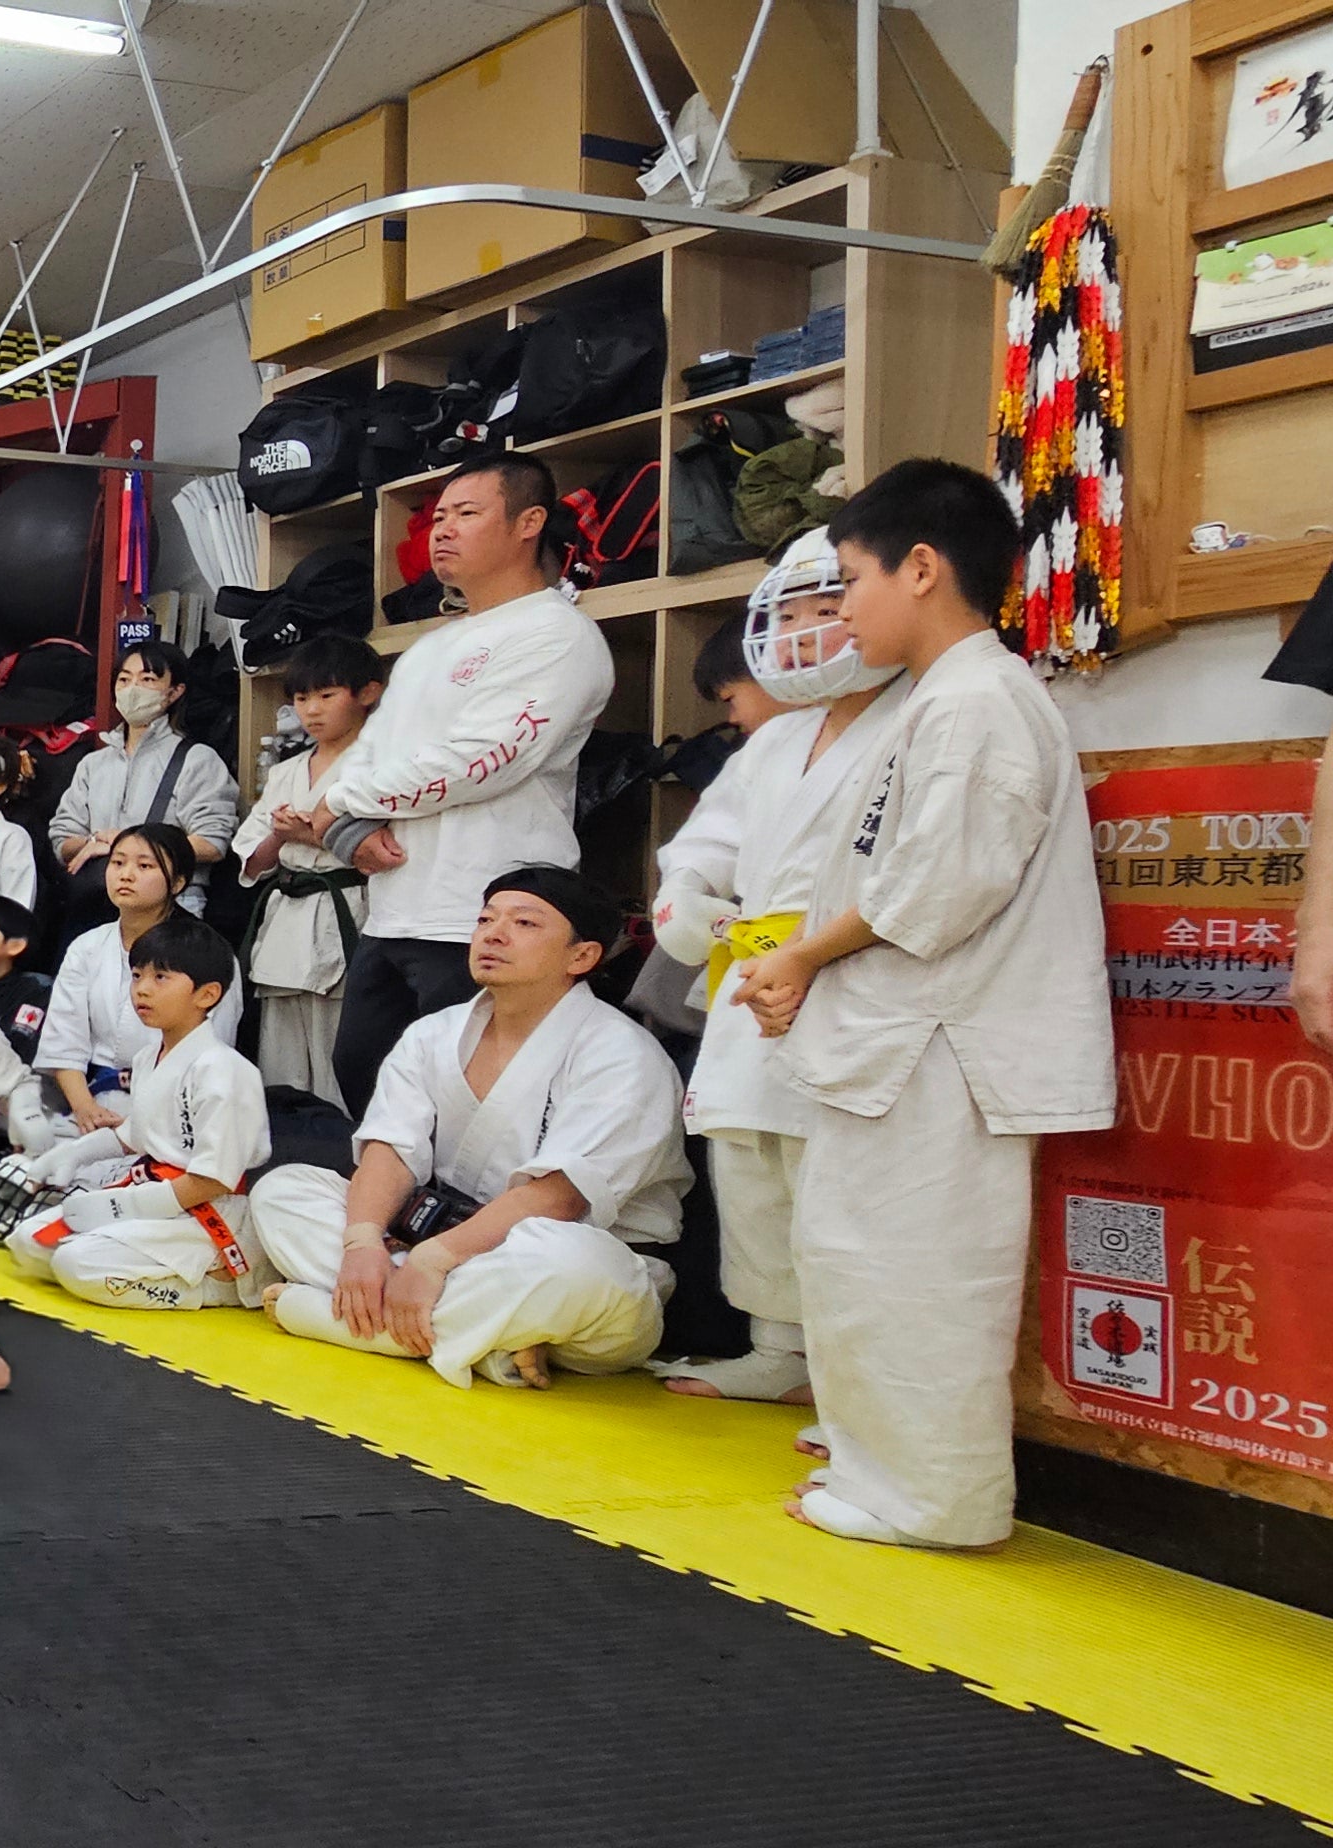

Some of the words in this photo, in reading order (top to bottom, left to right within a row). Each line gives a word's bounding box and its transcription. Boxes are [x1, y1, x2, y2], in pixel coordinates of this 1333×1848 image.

[263, 440, 288, 454] THE
[249, 450, 288, 468] NORTH
[257, 461, 288, 476] FACE
[120, 624, 151, 638] PASS
[377, 776, 448, 814] サンタ
[466, 698, 551, 786] クルーズ
[1181, 1236, 1259, 1366] 伝説
[1189, 1377, 1329, 1439] 2025
